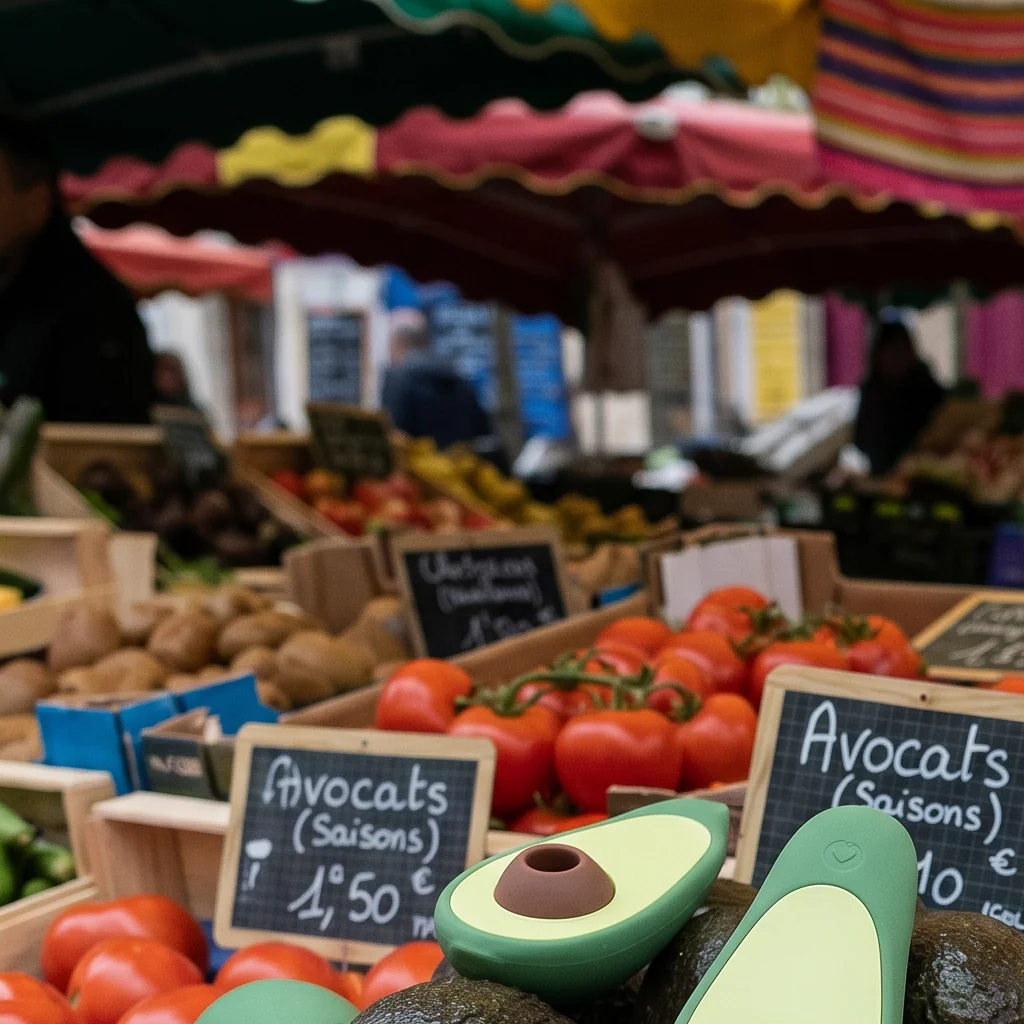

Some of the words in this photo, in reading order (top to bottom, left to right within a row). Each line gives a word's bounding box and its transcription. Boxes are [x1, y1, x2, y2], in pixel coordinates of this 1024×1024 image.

[799, 700, 1010, 788] Avocats
[262, 754, 449, 816] Avocats
[292, 807, 440, 864] (Saisons)
